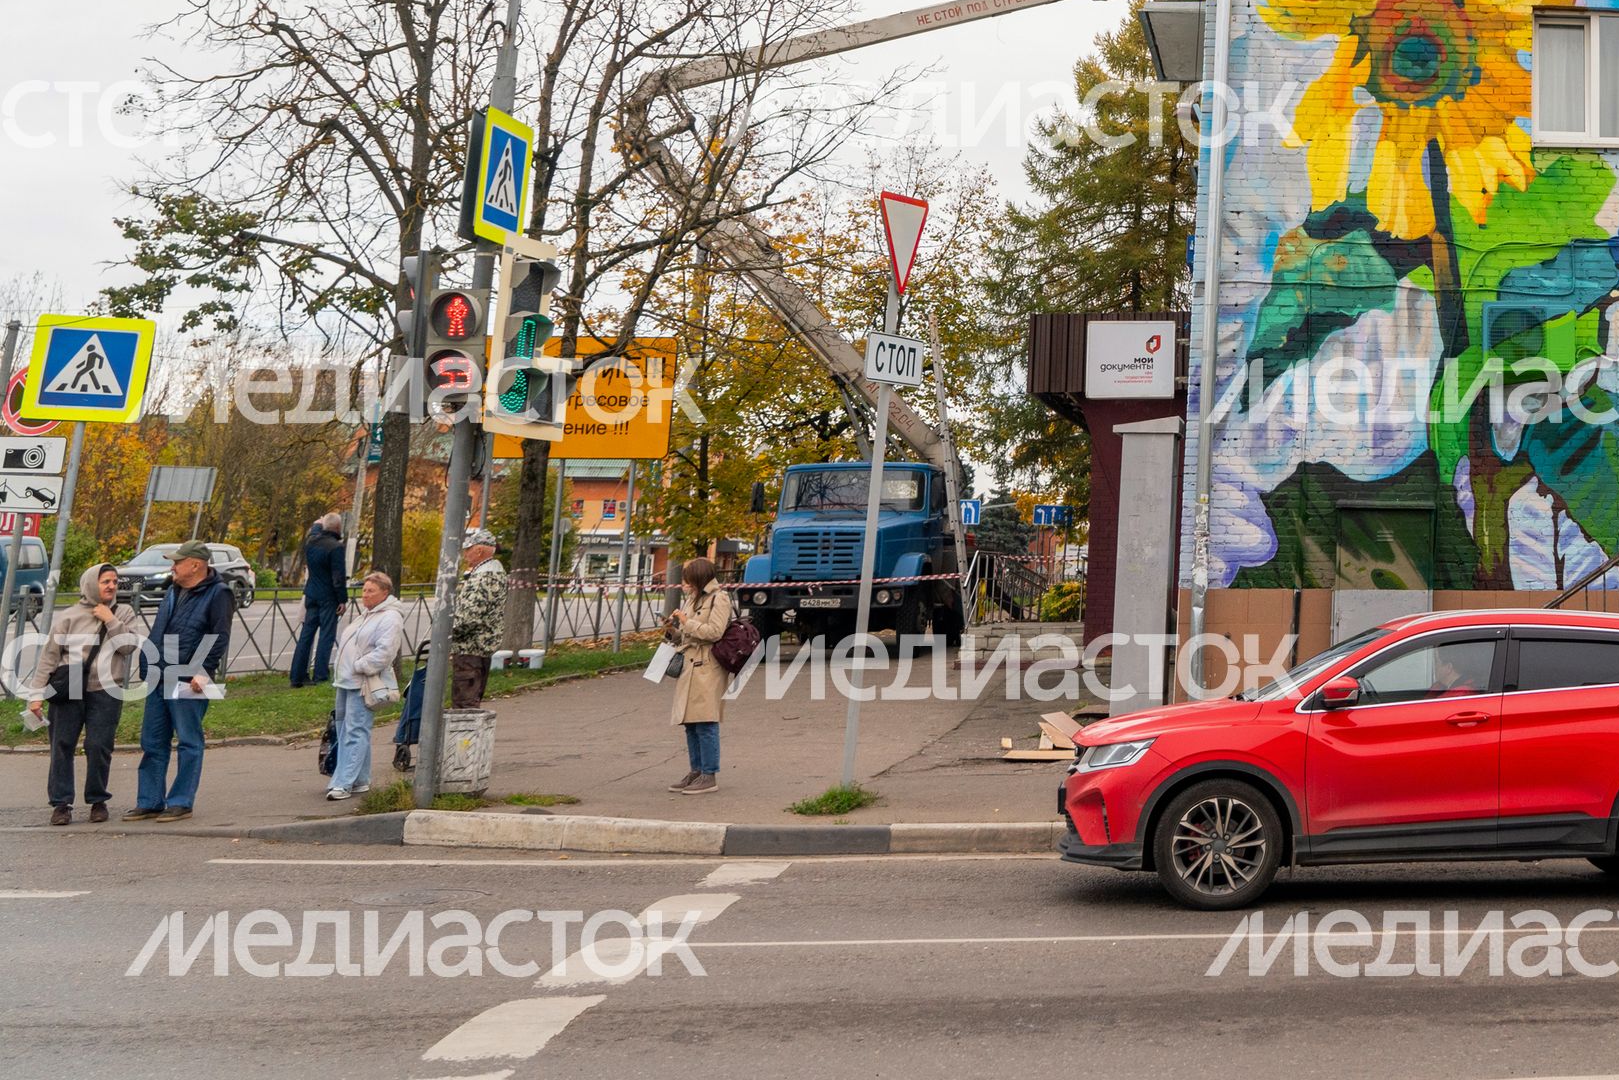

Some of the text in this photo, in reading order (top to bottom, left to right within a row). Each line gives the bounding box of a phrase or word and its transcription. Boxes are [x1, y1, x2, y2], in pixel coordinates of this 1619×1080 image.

[916, 14, 931, 26] НЕ
[934, 4, 963, 22] СТОЙ
[967, 1, 989, 14] ПОД
[875, 340, 916, 377] СТОП
[563, 423, 607, 435] ение
